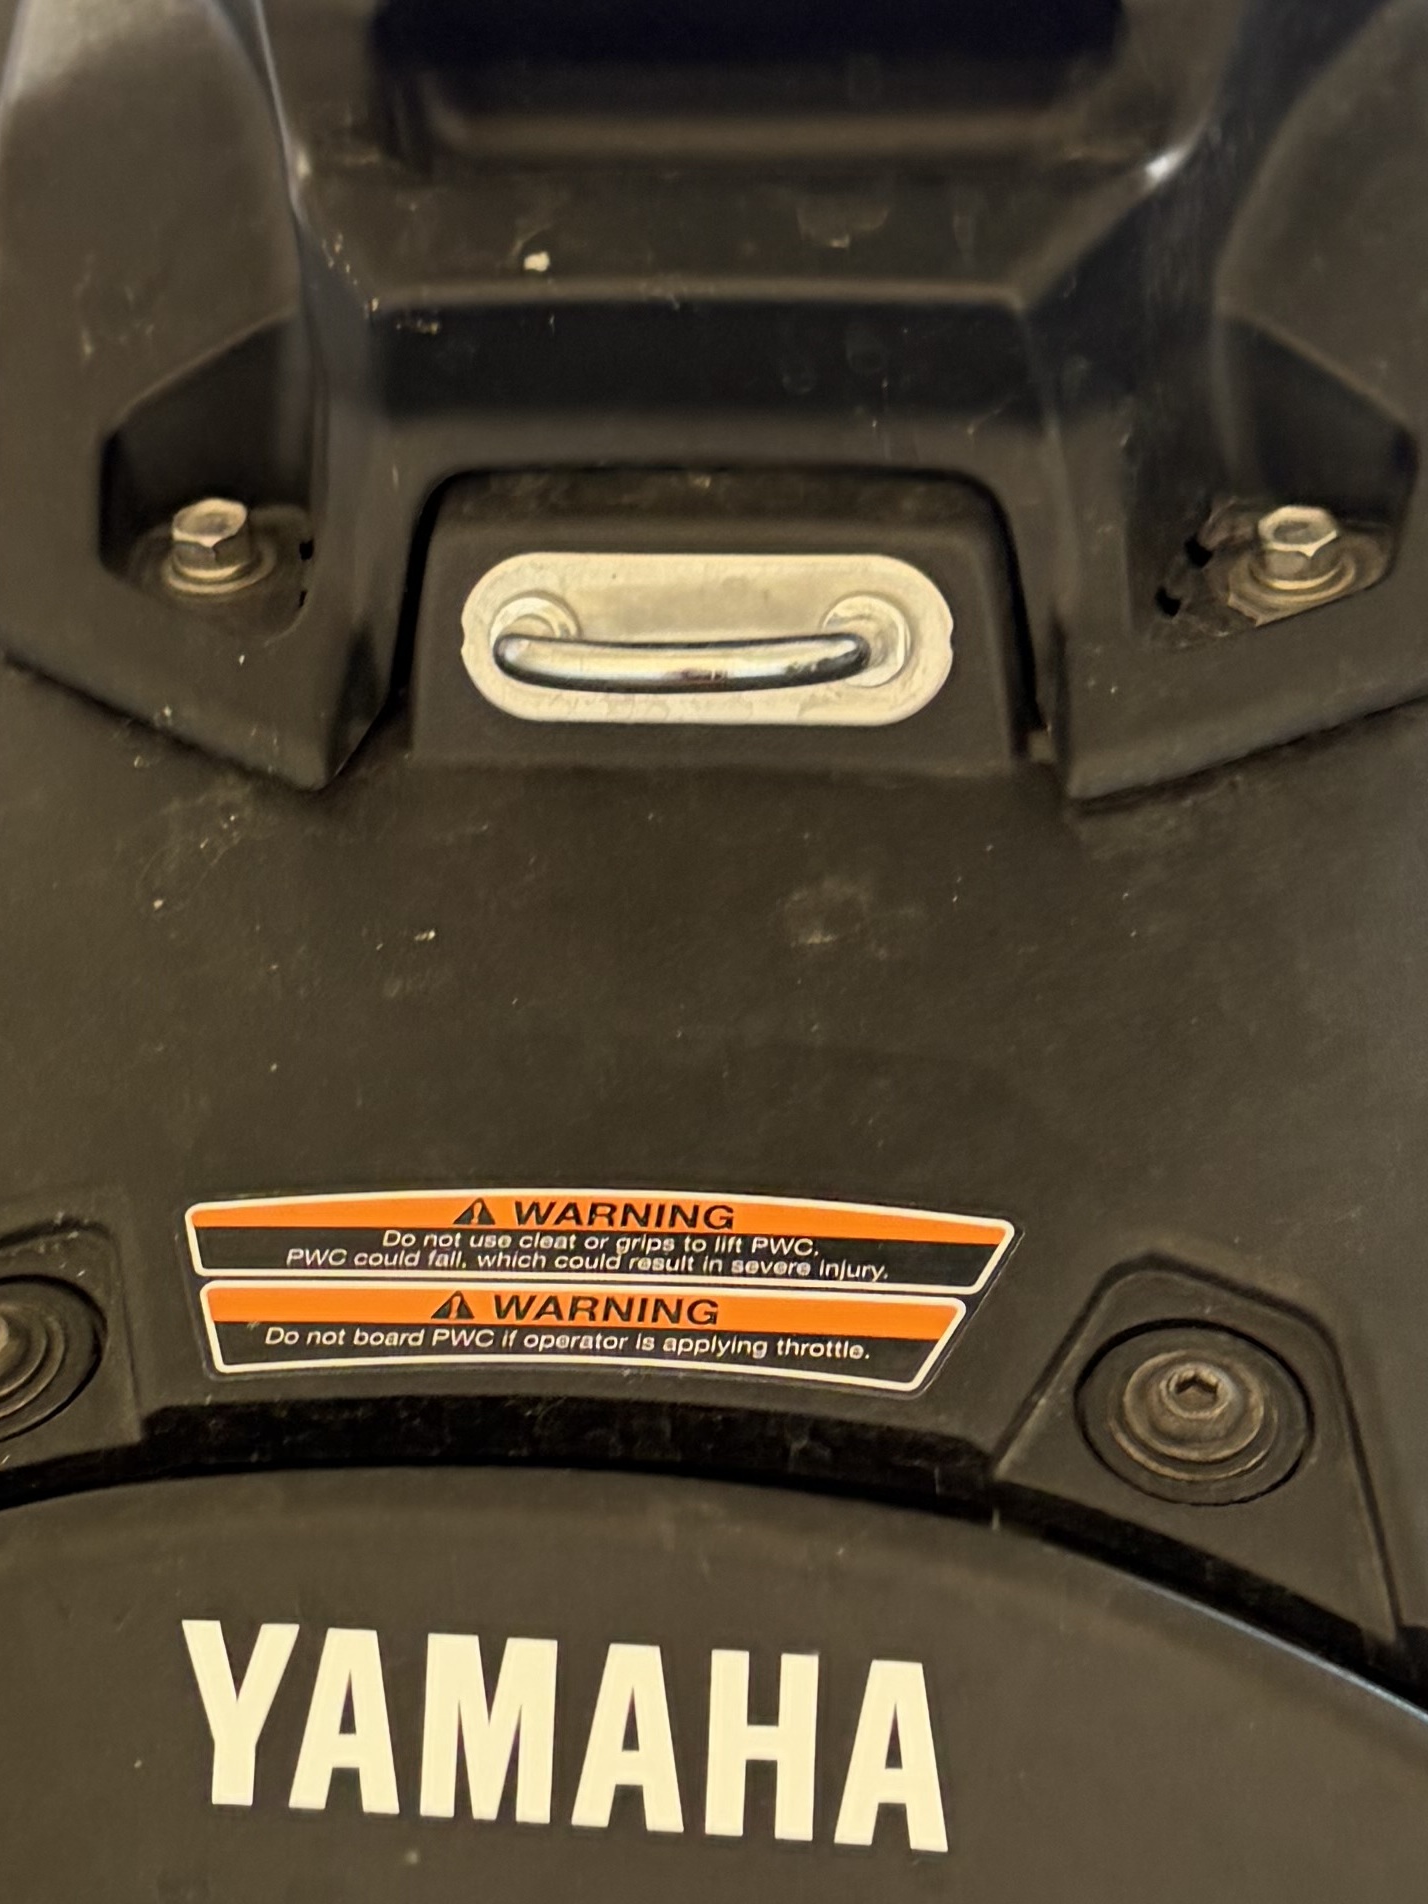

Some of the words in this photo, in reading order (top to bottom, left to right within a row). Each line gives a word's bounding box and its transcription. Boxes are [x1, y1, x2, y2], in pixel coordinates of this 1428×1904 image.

[514, 1200, 735, 1230] WARNING
[382, 1229, 416, 1247] Do
[423, 1231, 462, 1248] not
[468, 1233, 512, 1249] use
[518, 1231, 577, 1249] cleat
[584, 1235, 610, 1250] or
[615, 1234, 675, 1255] grips
[683, 1236, 708, 1253] to
[713, 1235, 744, 1254] lift
[285, 1248, 348, 1268] PWC
[353, 1249, 422, 1268] could
[476, 1251, 547, 1269] which
[554, 1252, 622, 1271] could
[628, 1254, 695, 1272] result
[703, 1255, 724, 1273] in
[731, 1257, 812, 1277] severe
[819, 1258, 890, 1283] injury.
[493, 1294, 719, 1326] WARNING
[264, 1326, 300, 1345] Do
[306, 1328, 345, 1346] not
[353, 1327, 425, 1346] board
[431, 1329, 495, 1347] PWC
[501, 1329, 519, 1348] if
[523, 1332, 628, 1352] operator
[635, 1332, 655, 1351] is
[662, 1334, 768, 1359] applying
[776, 1337, 871, 1360] throttle.
[182, 1619, 948, 1853] YAMAHA
